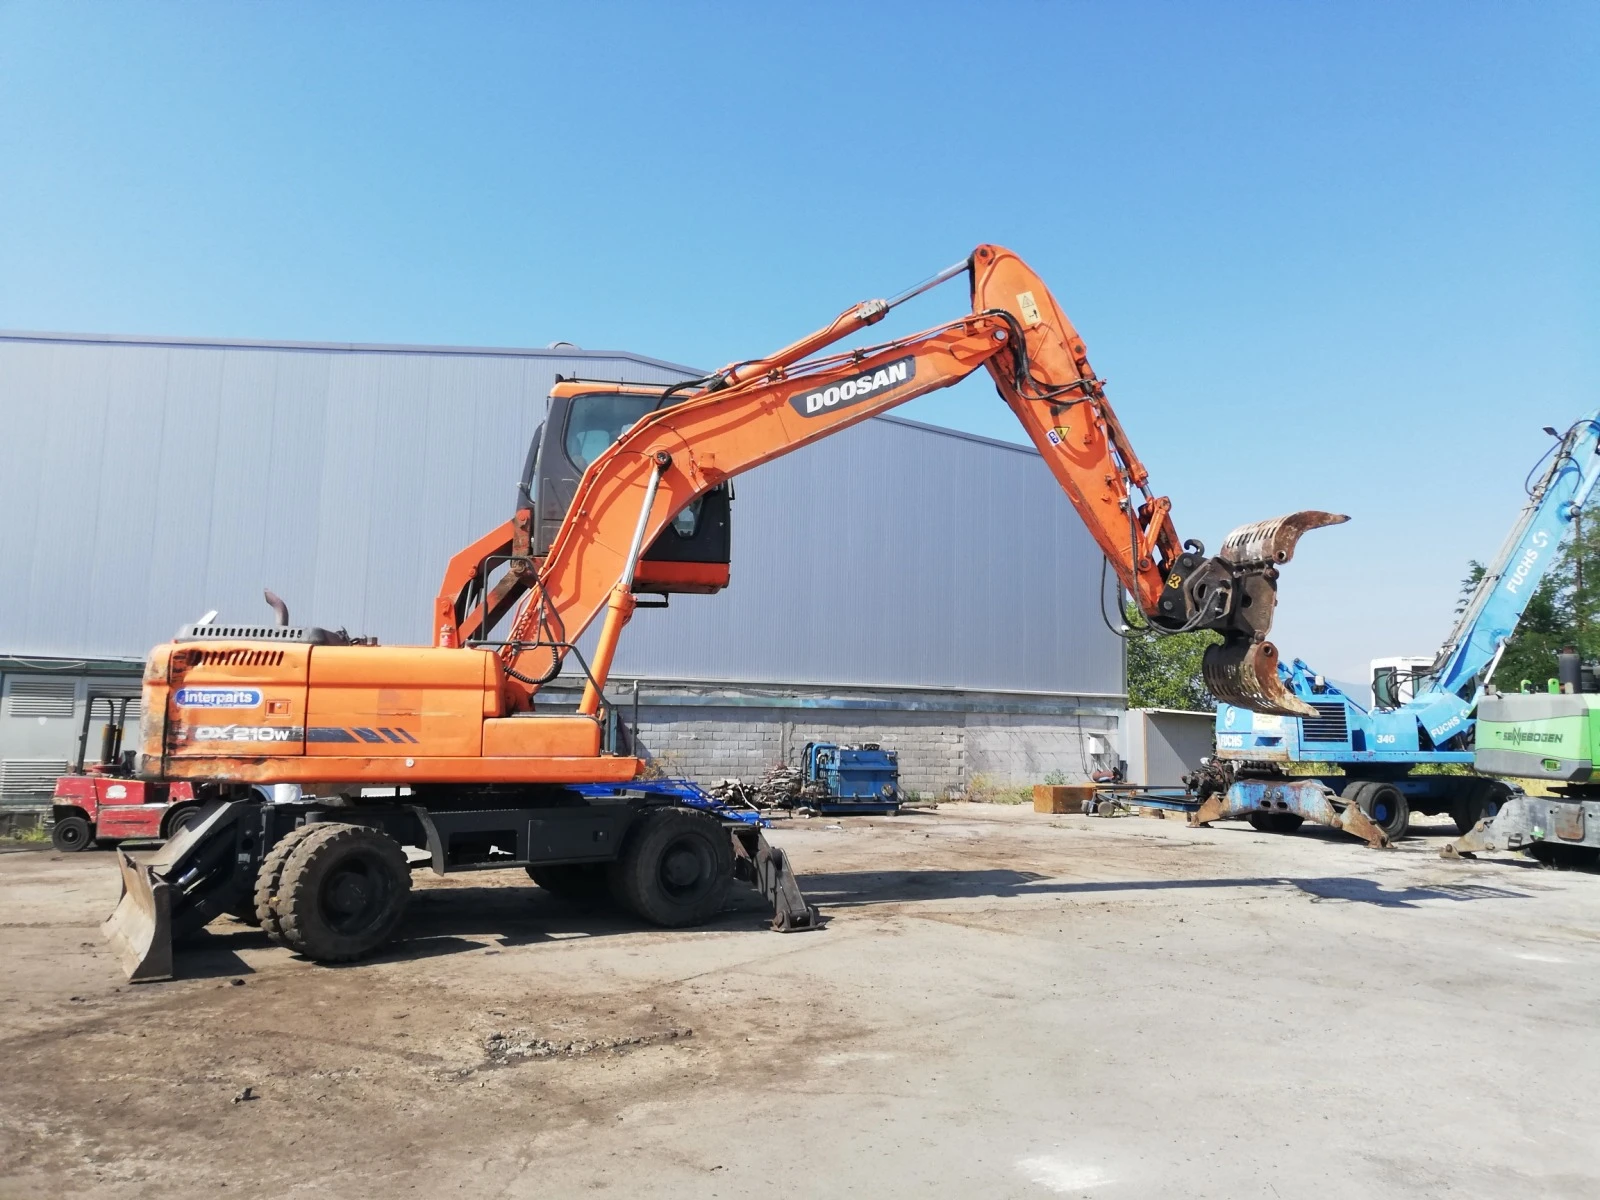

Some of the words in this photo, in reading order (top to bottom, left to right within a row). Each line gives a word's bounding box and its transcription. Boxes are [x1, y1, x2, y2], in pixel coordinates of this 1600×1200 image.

[807, 362, 906, 413] DOOSAN
[1506, 549, 1539, 594] FUCHS
[185, 691, 252, 704] interparts
[1431, 716, 1460, 738] FUCHS
[1221, 734, 1243, 747] FUCHS
